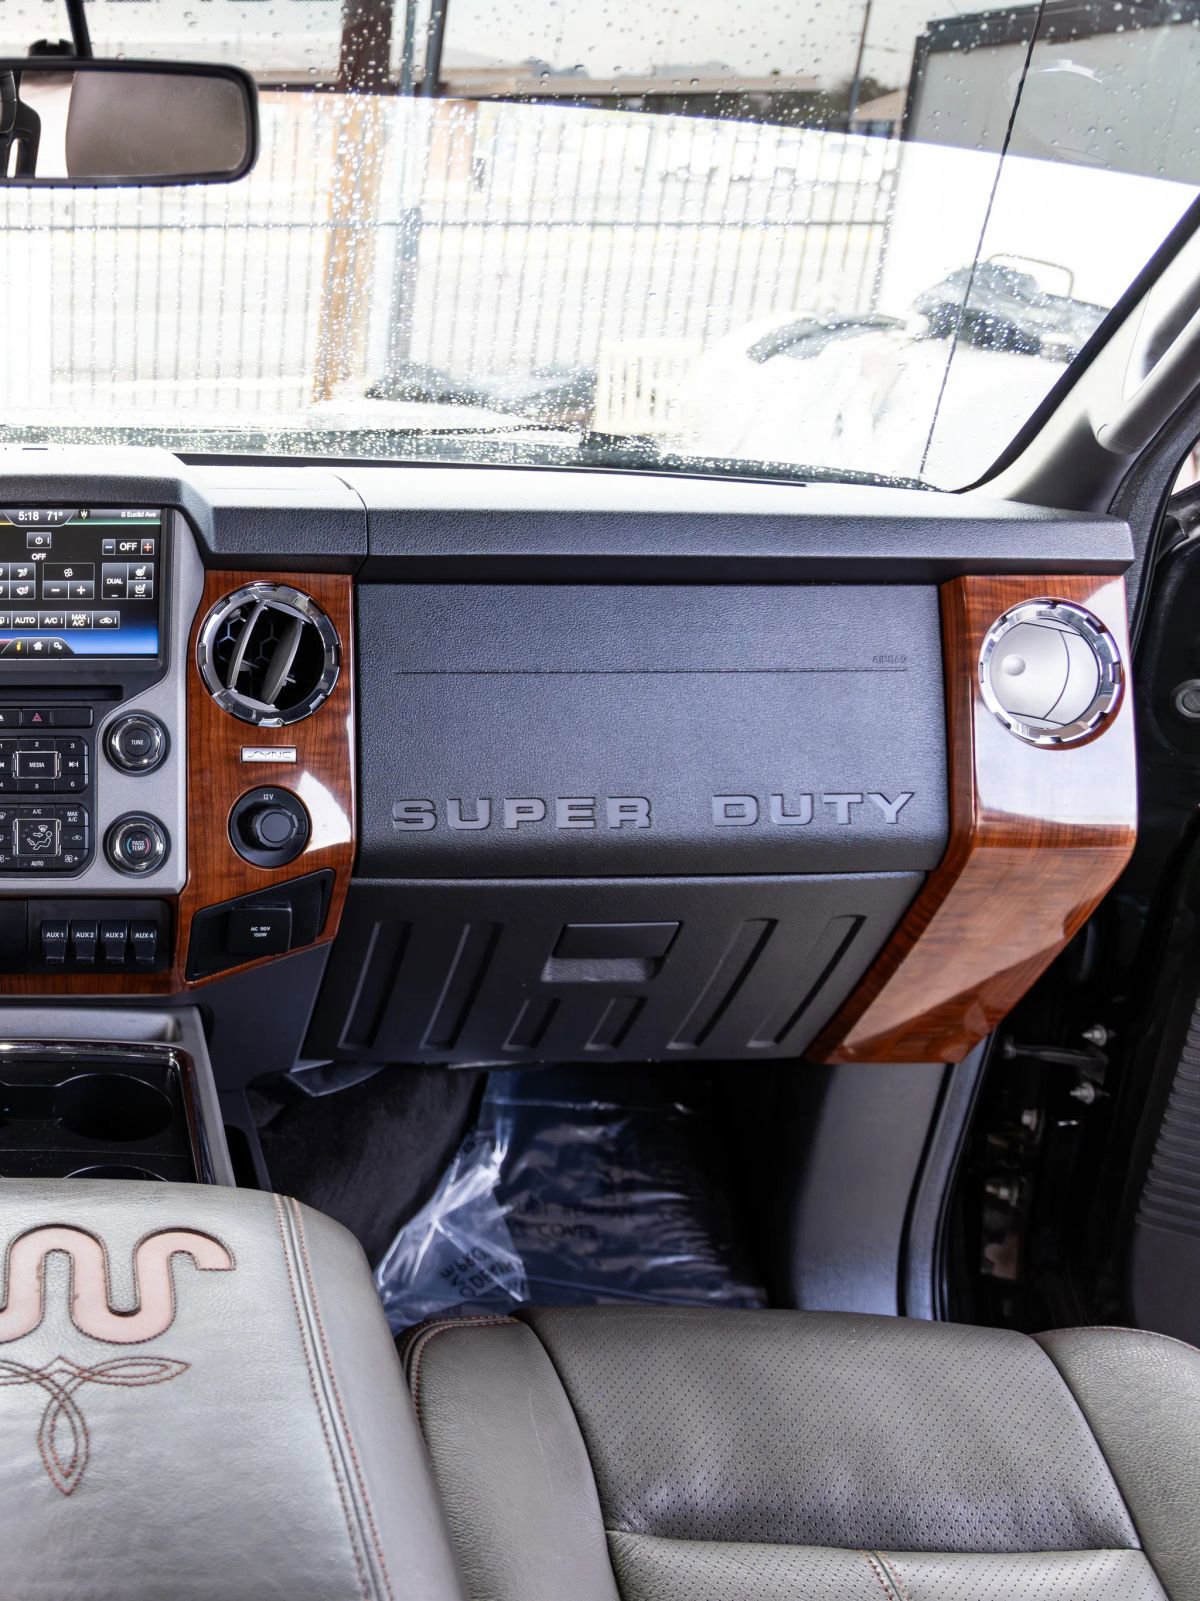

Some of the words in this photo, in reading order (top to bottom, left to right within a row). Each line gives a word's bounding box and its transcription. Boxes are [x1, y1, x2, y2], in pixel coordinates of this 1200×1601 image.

[18, 511, 40, 520] 5:18
[120, 542, 138, 551] OFF
[247, 750, 292, 759] SYNC
[391, 795, 653, 832] SUPER
[711, 790, 915, 828] DUTY
